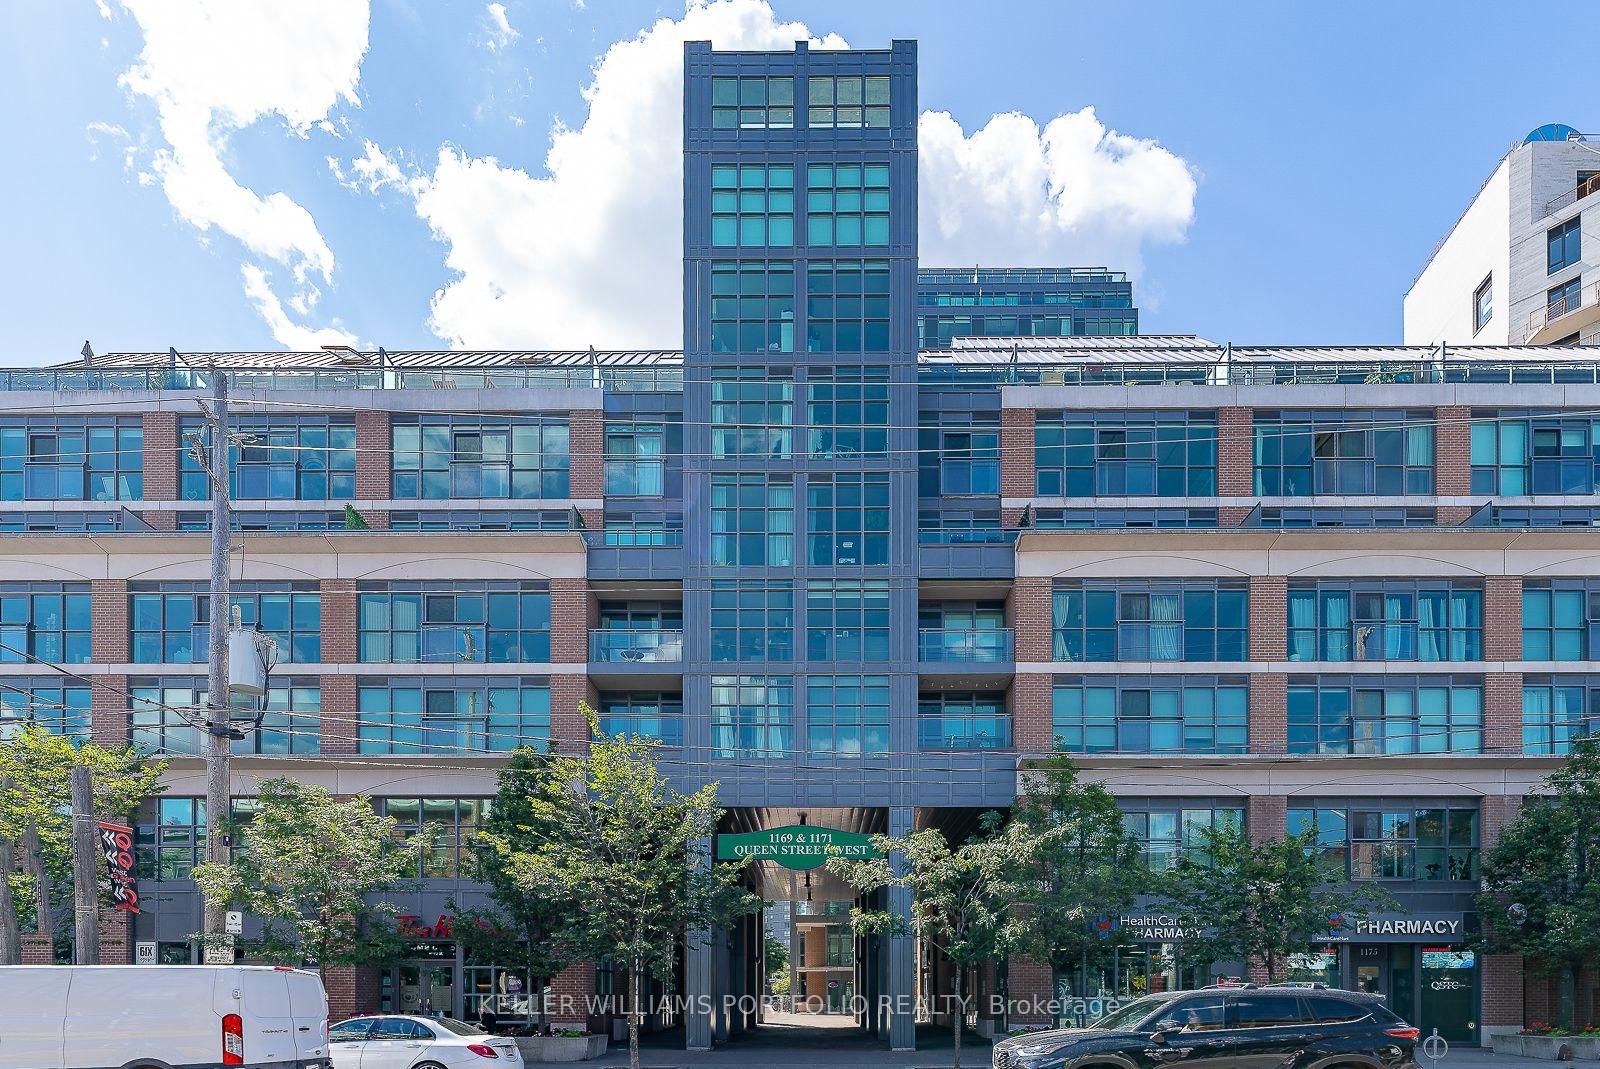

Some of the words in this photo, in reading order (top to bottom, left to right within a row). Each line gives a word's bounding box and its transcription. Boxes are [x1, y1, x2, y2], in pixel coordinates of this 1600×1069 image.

[769, 833, 793, 843] 1169
[796, 833, 806, 843] &
[810, 833, 832, 843] 1171
[734, 845, 778, 855] QUEEN
[781, 845, 828, 855] STREET
[1356, 920, 1459, 934] PHARMACY
[1360, 948, 1378, 956] 1175
